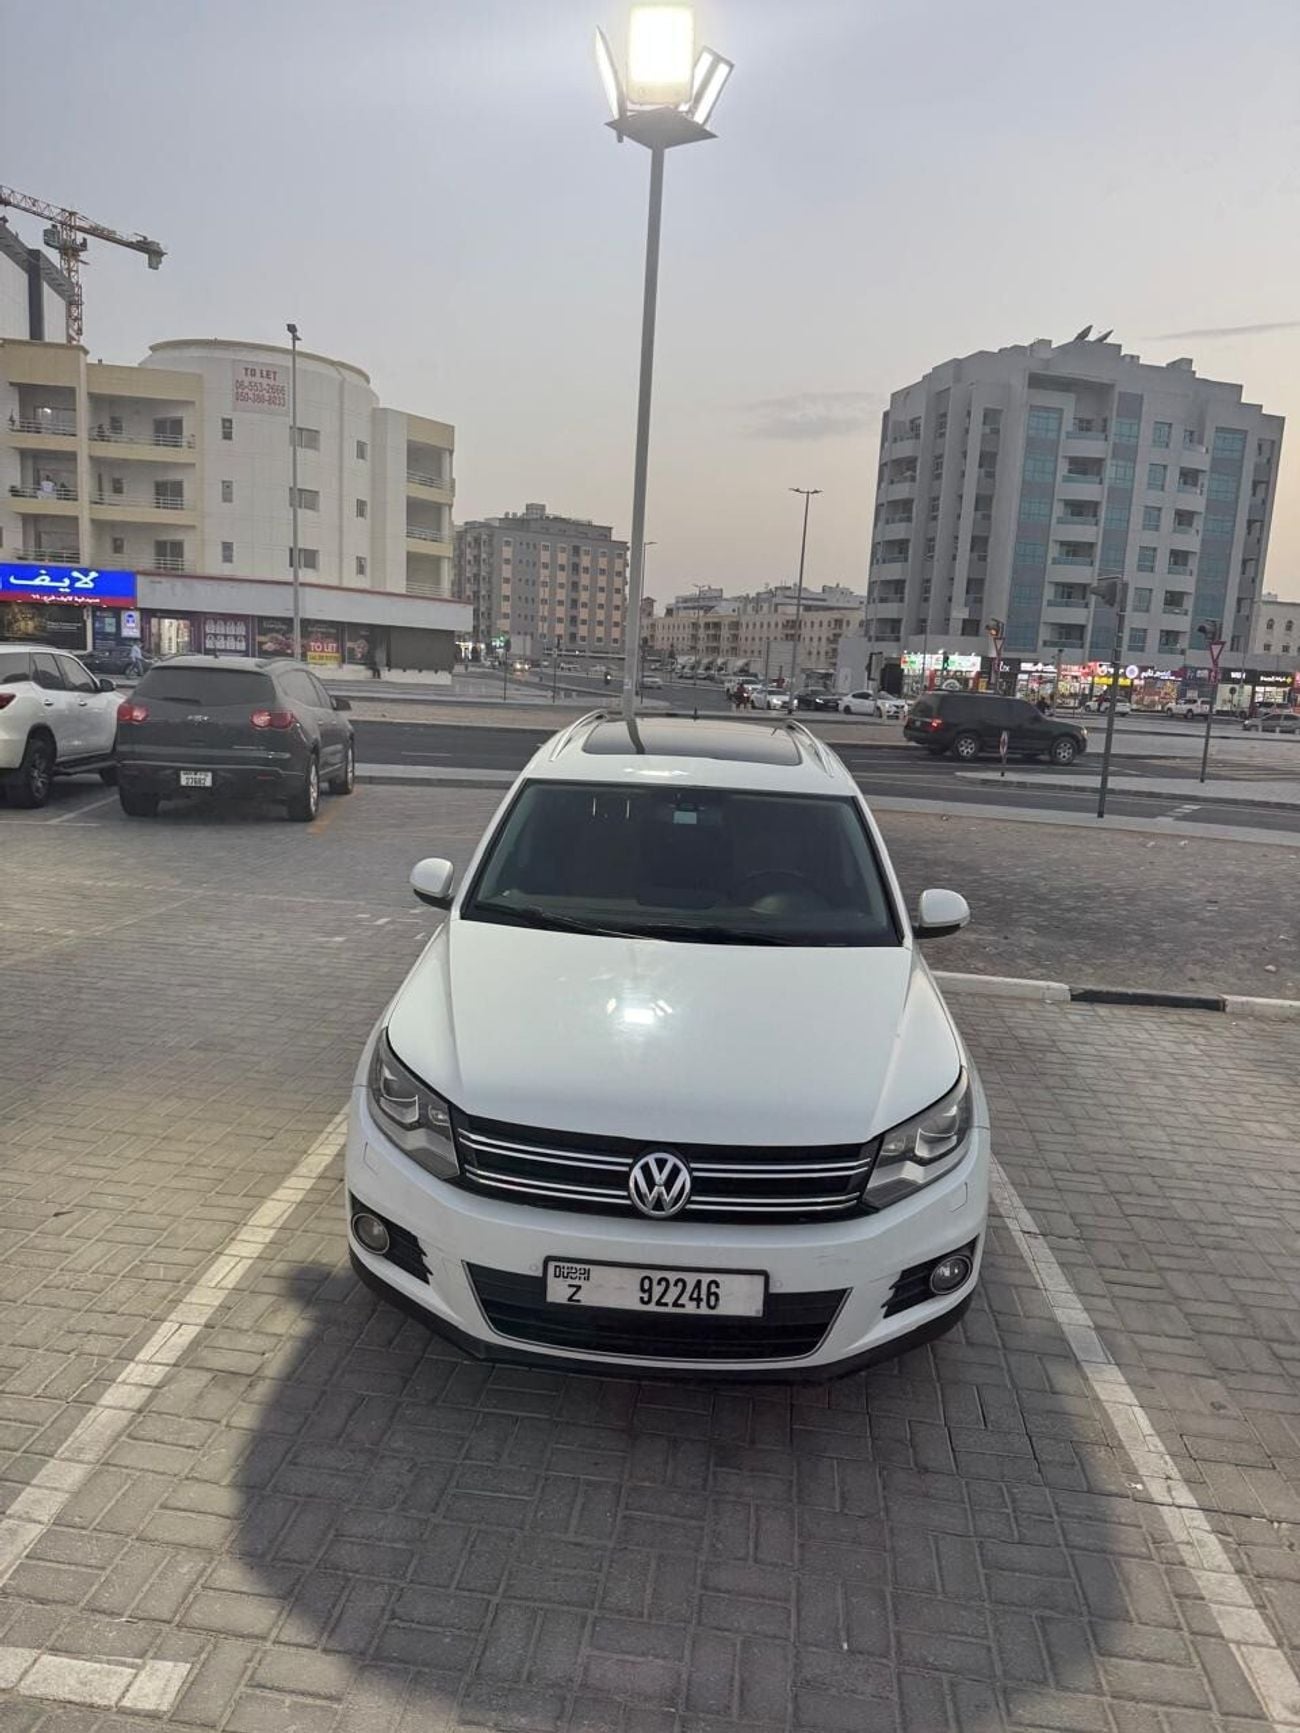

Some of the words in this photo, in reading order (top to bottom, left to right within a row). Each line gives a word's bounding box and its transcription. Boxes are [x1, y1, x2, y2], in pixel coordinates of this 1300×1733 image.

[243, 367, 256, 378] TO
[260, 369, 278, 381] LET
[9, 569, 99, 593] لايف
[310, 642, 322, 652] TO
[324, 643, 337, 653] LET
[567, 1283, 582, 1303] Z
[639, 1275, 721, 1310] 92246
